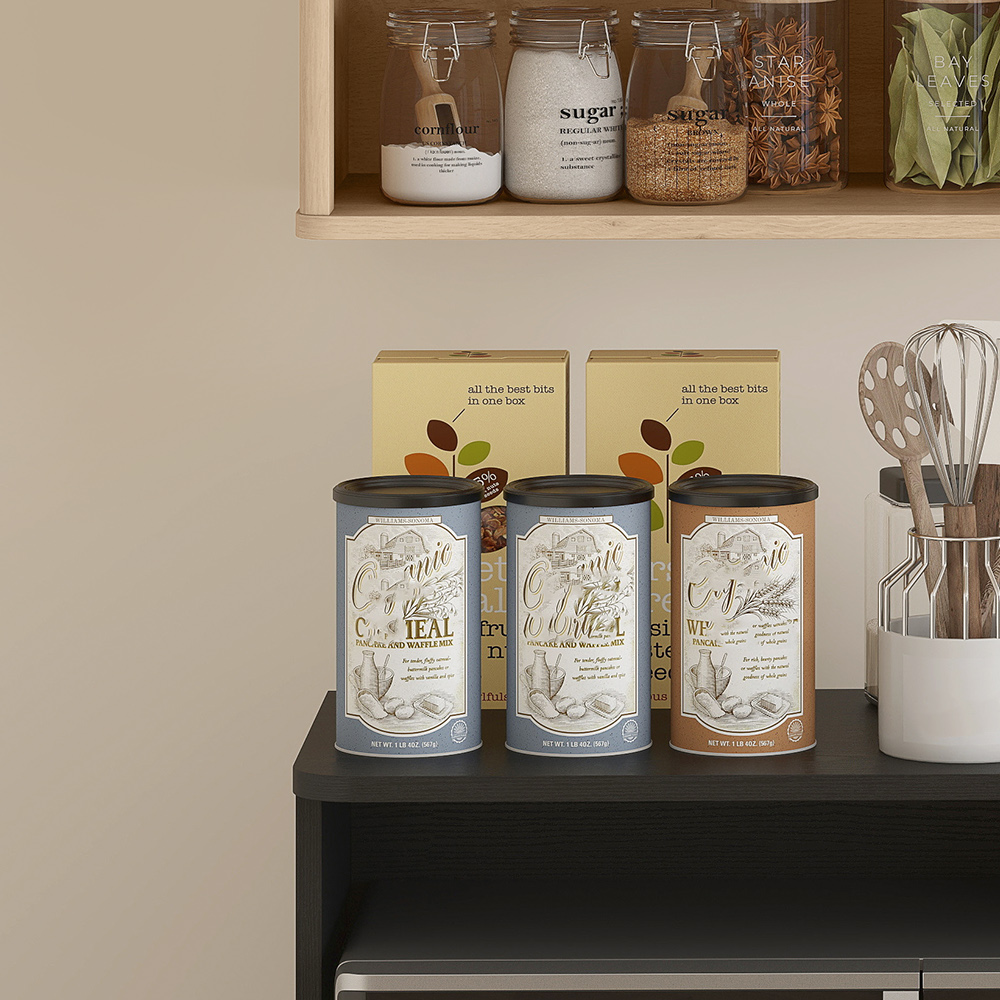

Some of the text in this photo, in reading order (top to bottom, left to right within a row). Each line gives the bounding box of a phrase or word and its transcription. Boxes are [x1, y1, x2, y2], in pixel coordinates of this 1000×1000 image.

[754, 55, 804, 68] STAR
[934, 55, 973, 68] BAY
[748, 75, 810, 88] ANISE
[916, 74, 990, 88] LEAVES
[560, 105, 616, 125] sugar
[667, 109, 729, 127] sugar
[414, 123, 480, 135] cornflour
[560, 126, 602, 135] REGULAR
[467, 385, 555, 394] all the best bits
[681, 384, 768, 393] all the best bits
[467, 396, 525, 405] in one box
[681, 396, 739, 405] in one box
[387, 641, 405, 650] AND
[407, 640, 438, 649] WAFFLE
[439, 639, 454, 647] MIX
